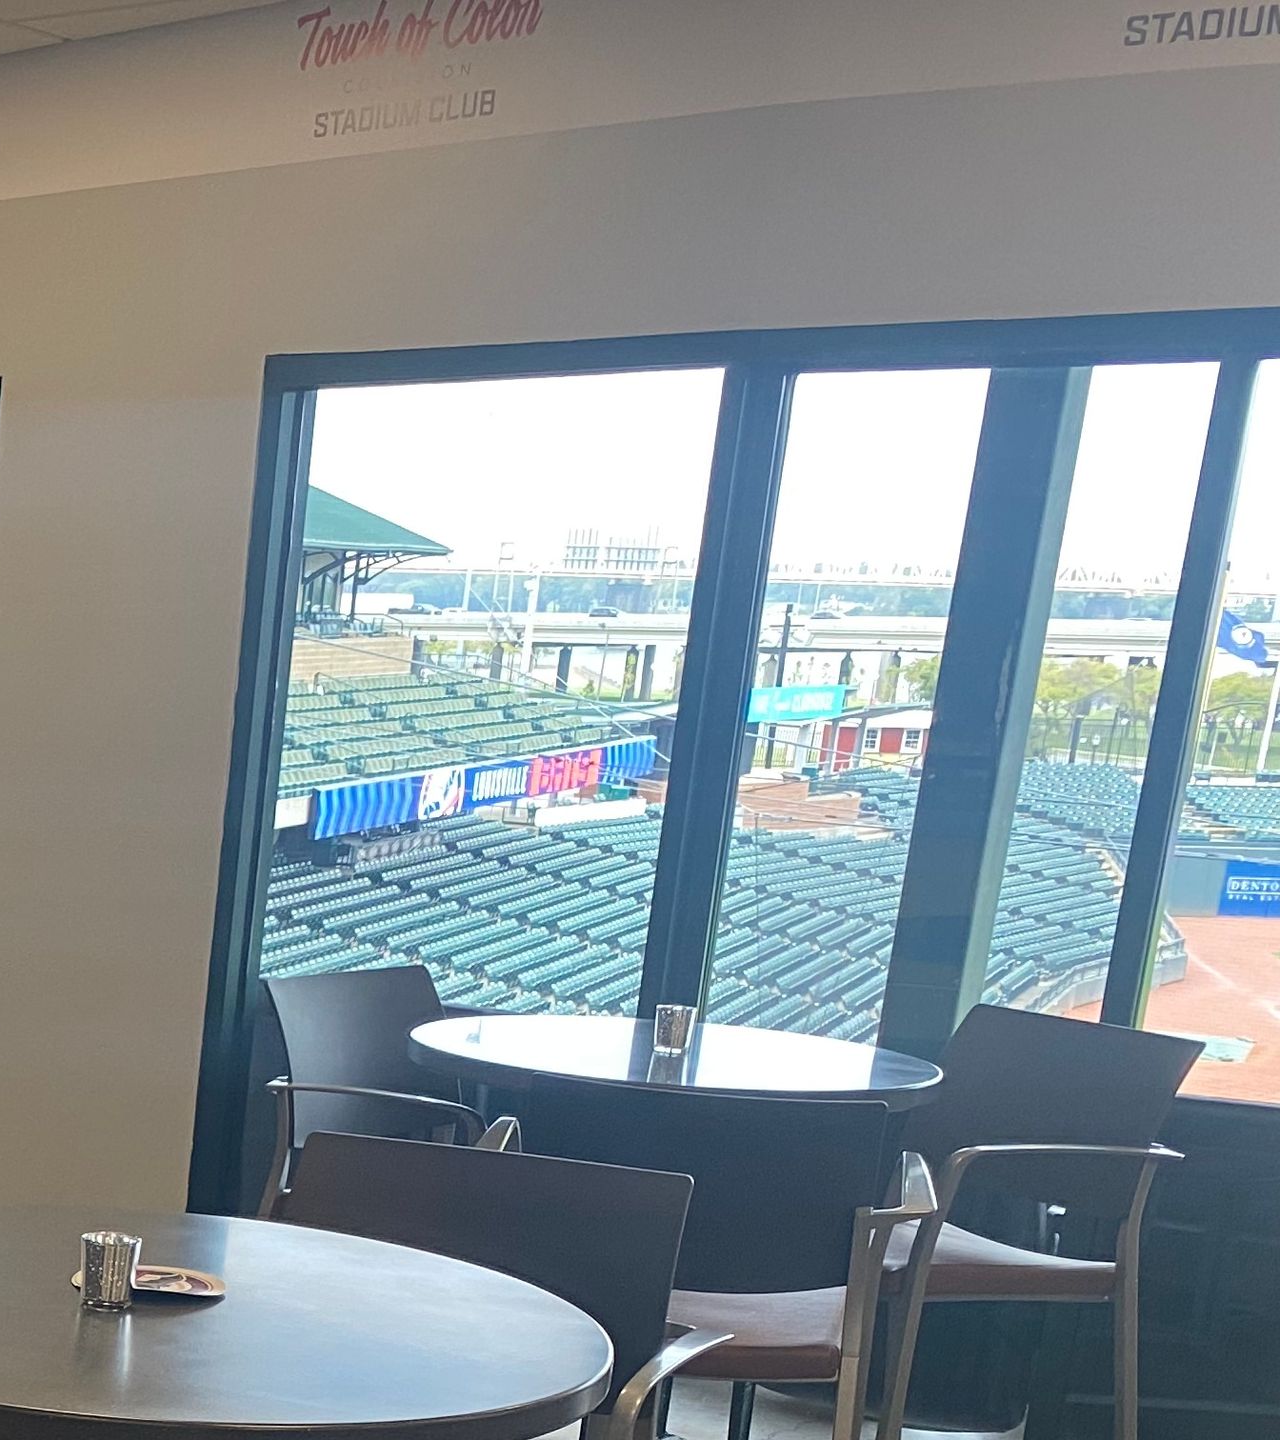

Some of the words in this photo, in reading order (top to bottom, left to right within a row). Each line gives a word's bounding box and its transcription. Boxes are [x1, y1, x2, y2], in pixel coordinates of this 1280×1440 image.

[297, 0, 390, 71] Touch
[397, 0, 439, 63] of
[313, 100, 421, 138] STADIUM
[428, 89, 496, 123] CLUB
